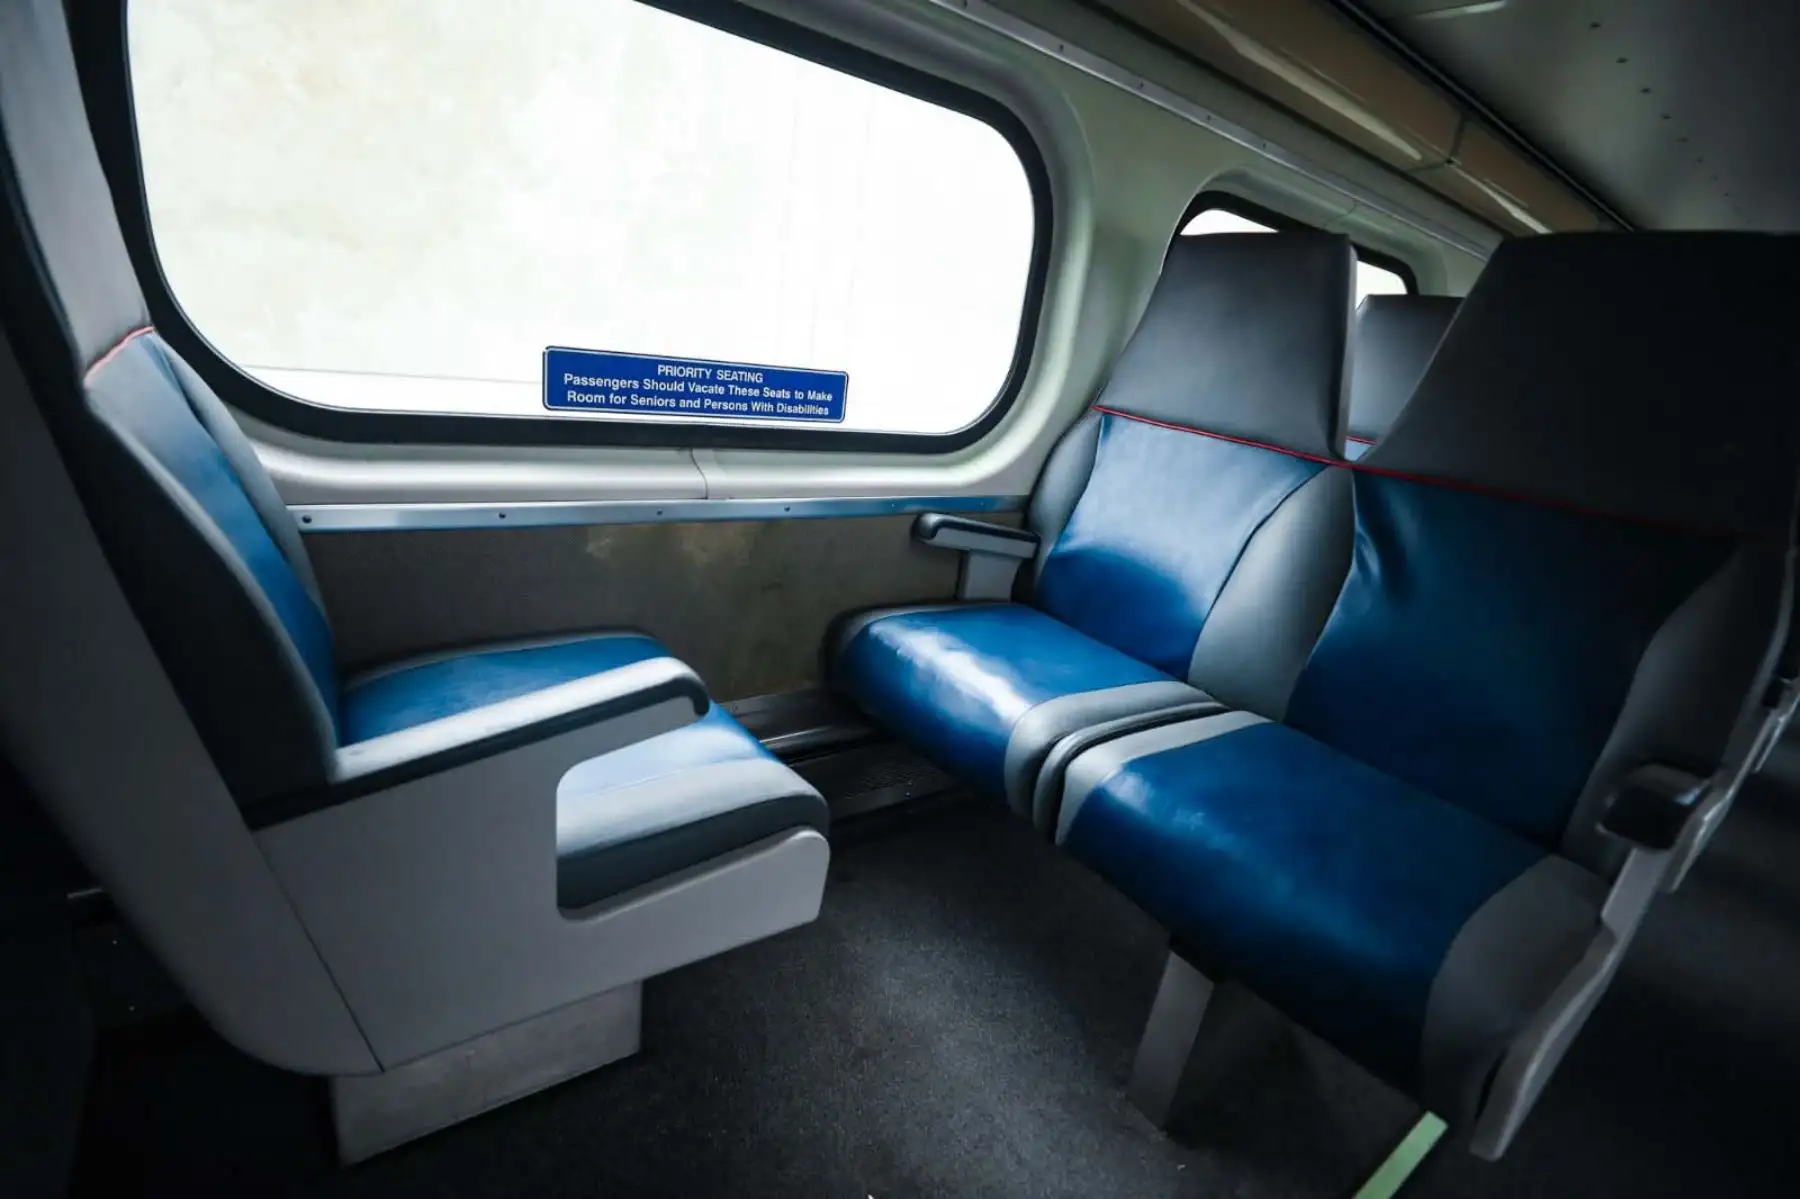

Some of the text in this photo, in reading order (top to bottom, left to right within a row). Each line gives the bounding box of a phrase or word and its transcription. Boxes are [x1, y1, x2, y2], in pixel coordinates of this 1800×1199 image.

[657, 365, 763, 383] PRIORITY SEATING
[564, 373, 833, 402] Passengers Should Vacate These Seats to Make
[567, 390, 829, 415] Room for Seniors and Persons With Disabilities
